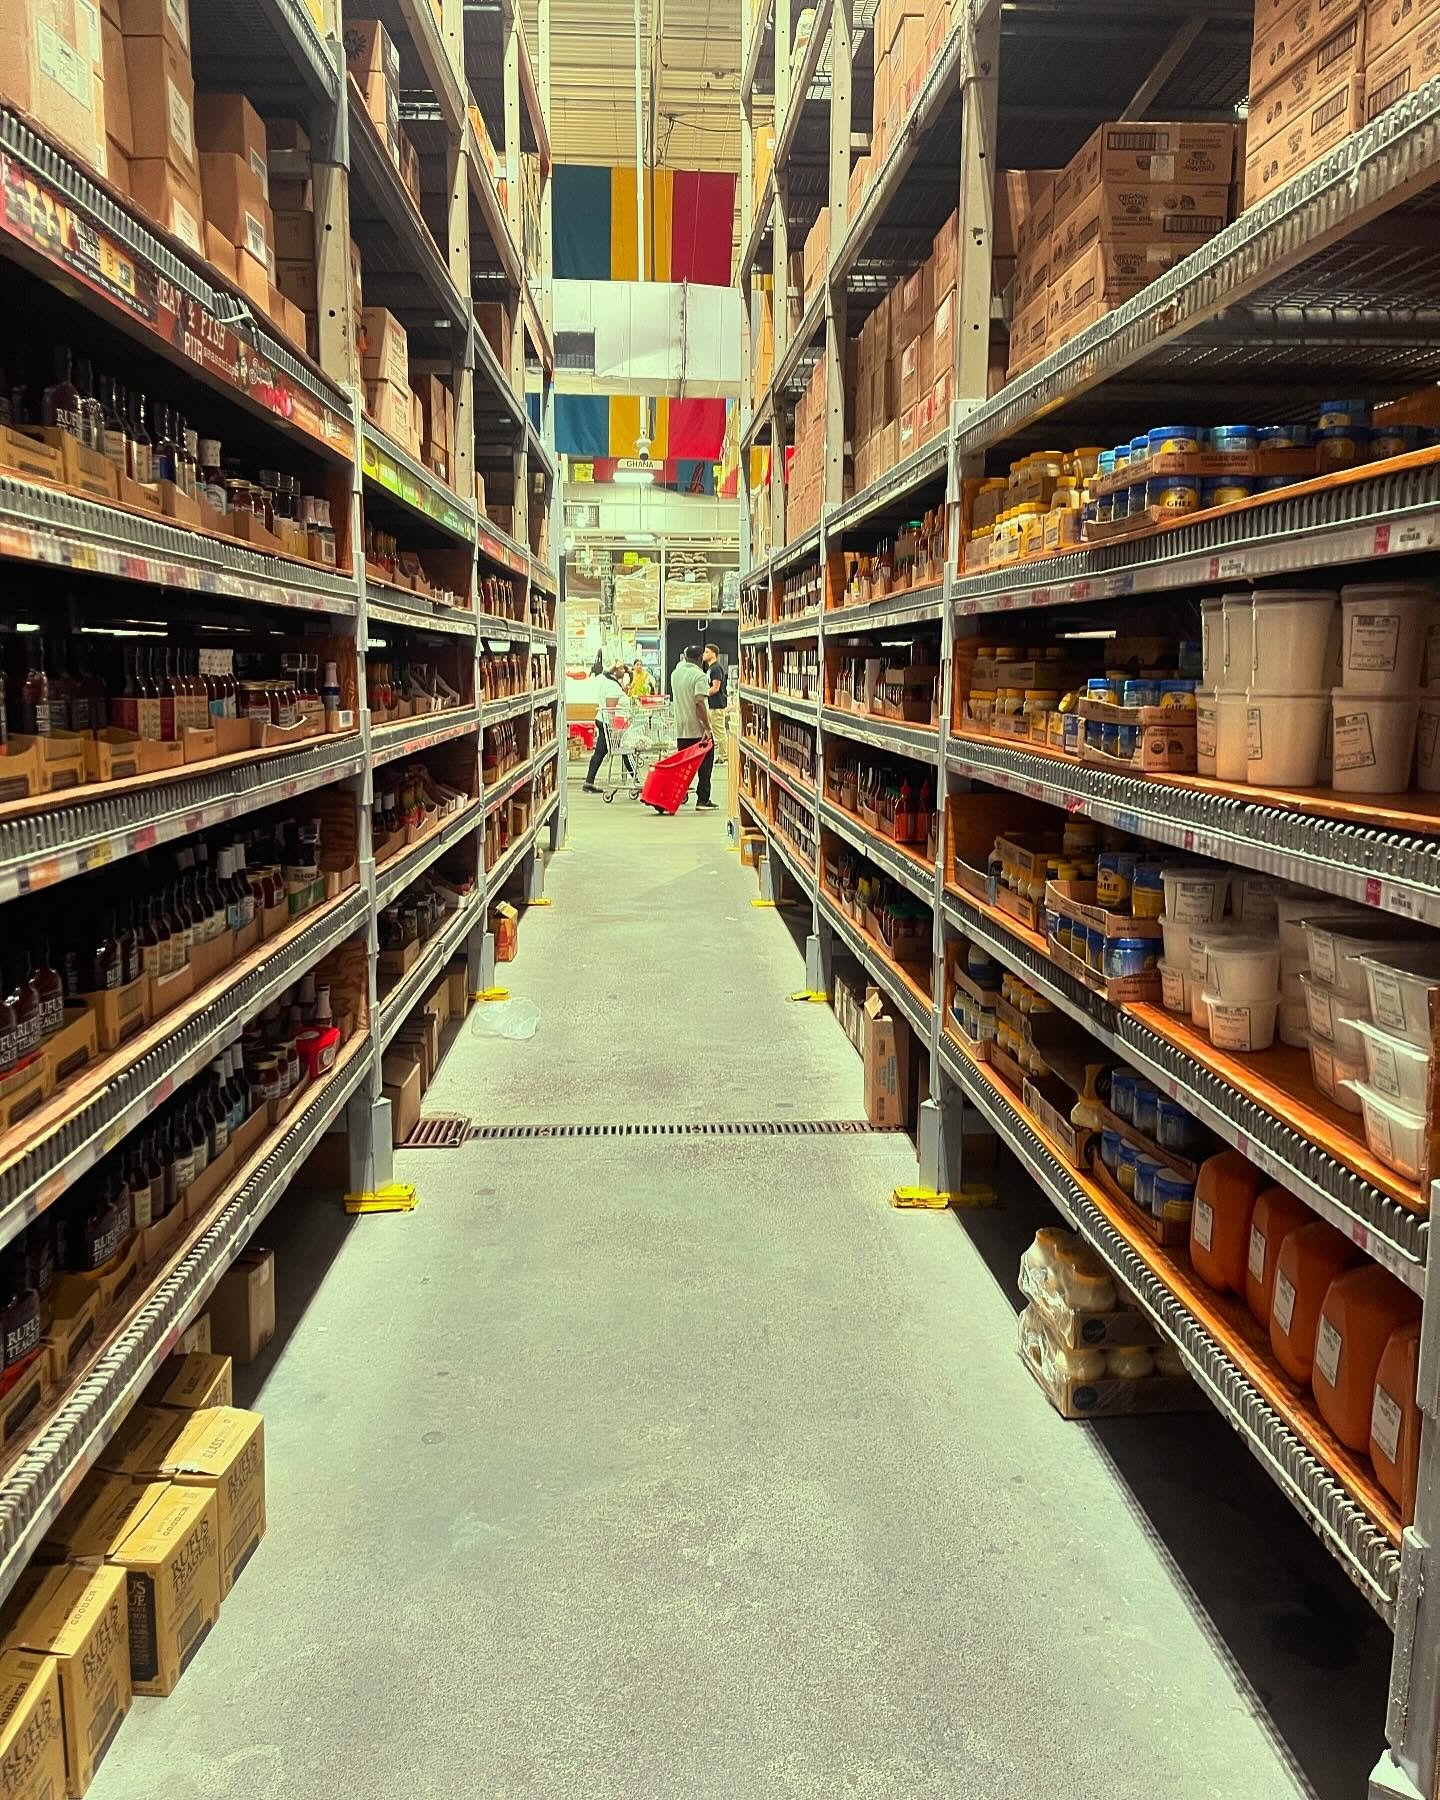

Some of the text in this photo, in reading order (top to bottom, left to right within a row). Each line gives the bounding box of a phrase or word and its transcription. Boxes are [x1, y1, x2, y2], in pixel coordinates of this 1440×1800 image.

[201, 308, 226, 351] FISH
[184, 331, 203, 366] RUB
[626, 460, 654, 469] GHANA
[1166, 500, 1192, 508] GHEE
[39, 996, 64, 1016] UFUS
[202, 1438, 226, 1460] GLASS
[227, 1435, 258, 1495] RUFUS
[162, 1506, 191, 1537] GOODER
[171, 1513, 209, 1581] RUFUS
[172, 1530, 209, 1594] TEAGUE
[70, 1589, 98, 1626] GOODER
[82, 1598, 119, 1676] RUFUS
[2, 1691, 51, 1779] RUFUS
